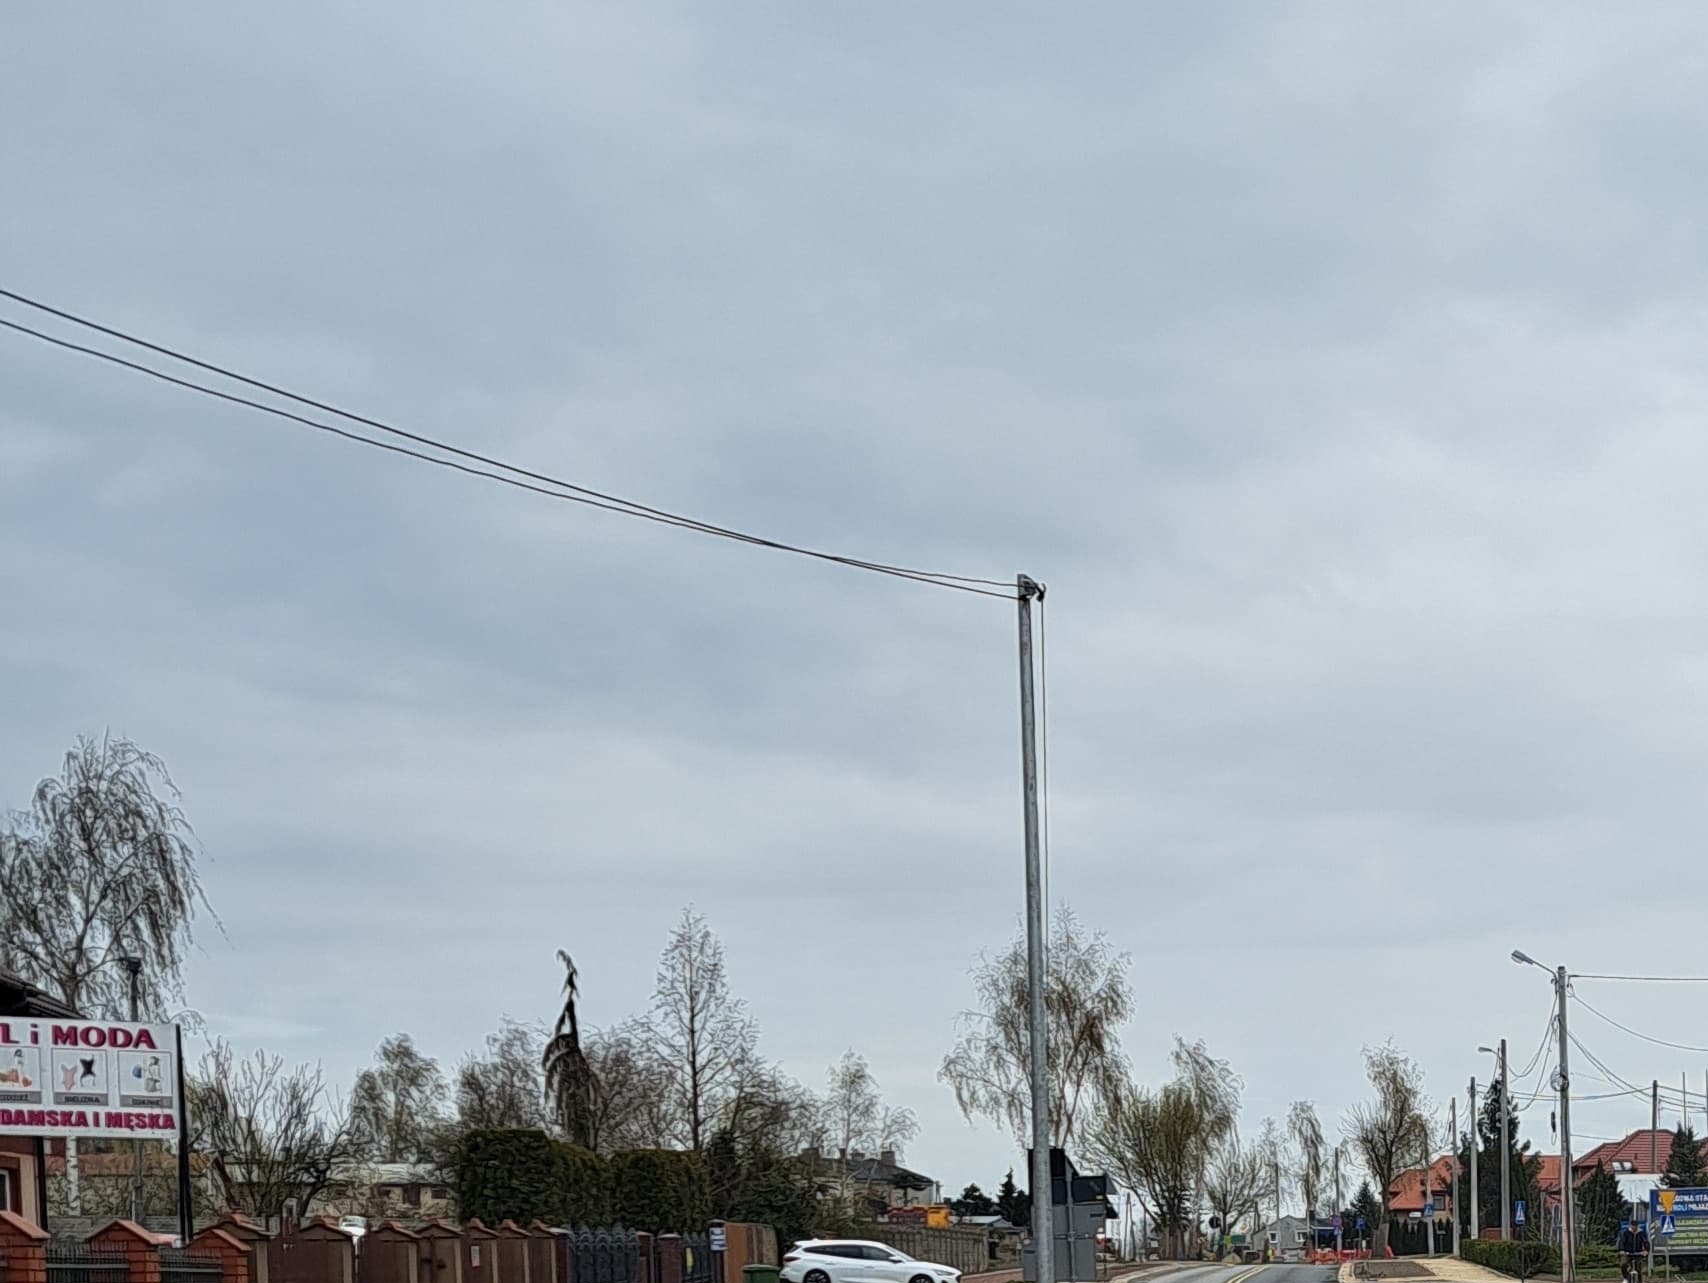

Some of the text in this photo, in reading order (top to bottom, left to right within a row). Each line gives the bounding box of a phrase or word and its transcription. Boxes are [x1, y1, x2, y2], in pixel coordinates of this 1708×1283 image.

[30, 1023, 39, 1045] i
[51, 1024, 157, 1049] MODA
[0, 1109, 176, 1132] DAMSKA I MĘSKA
